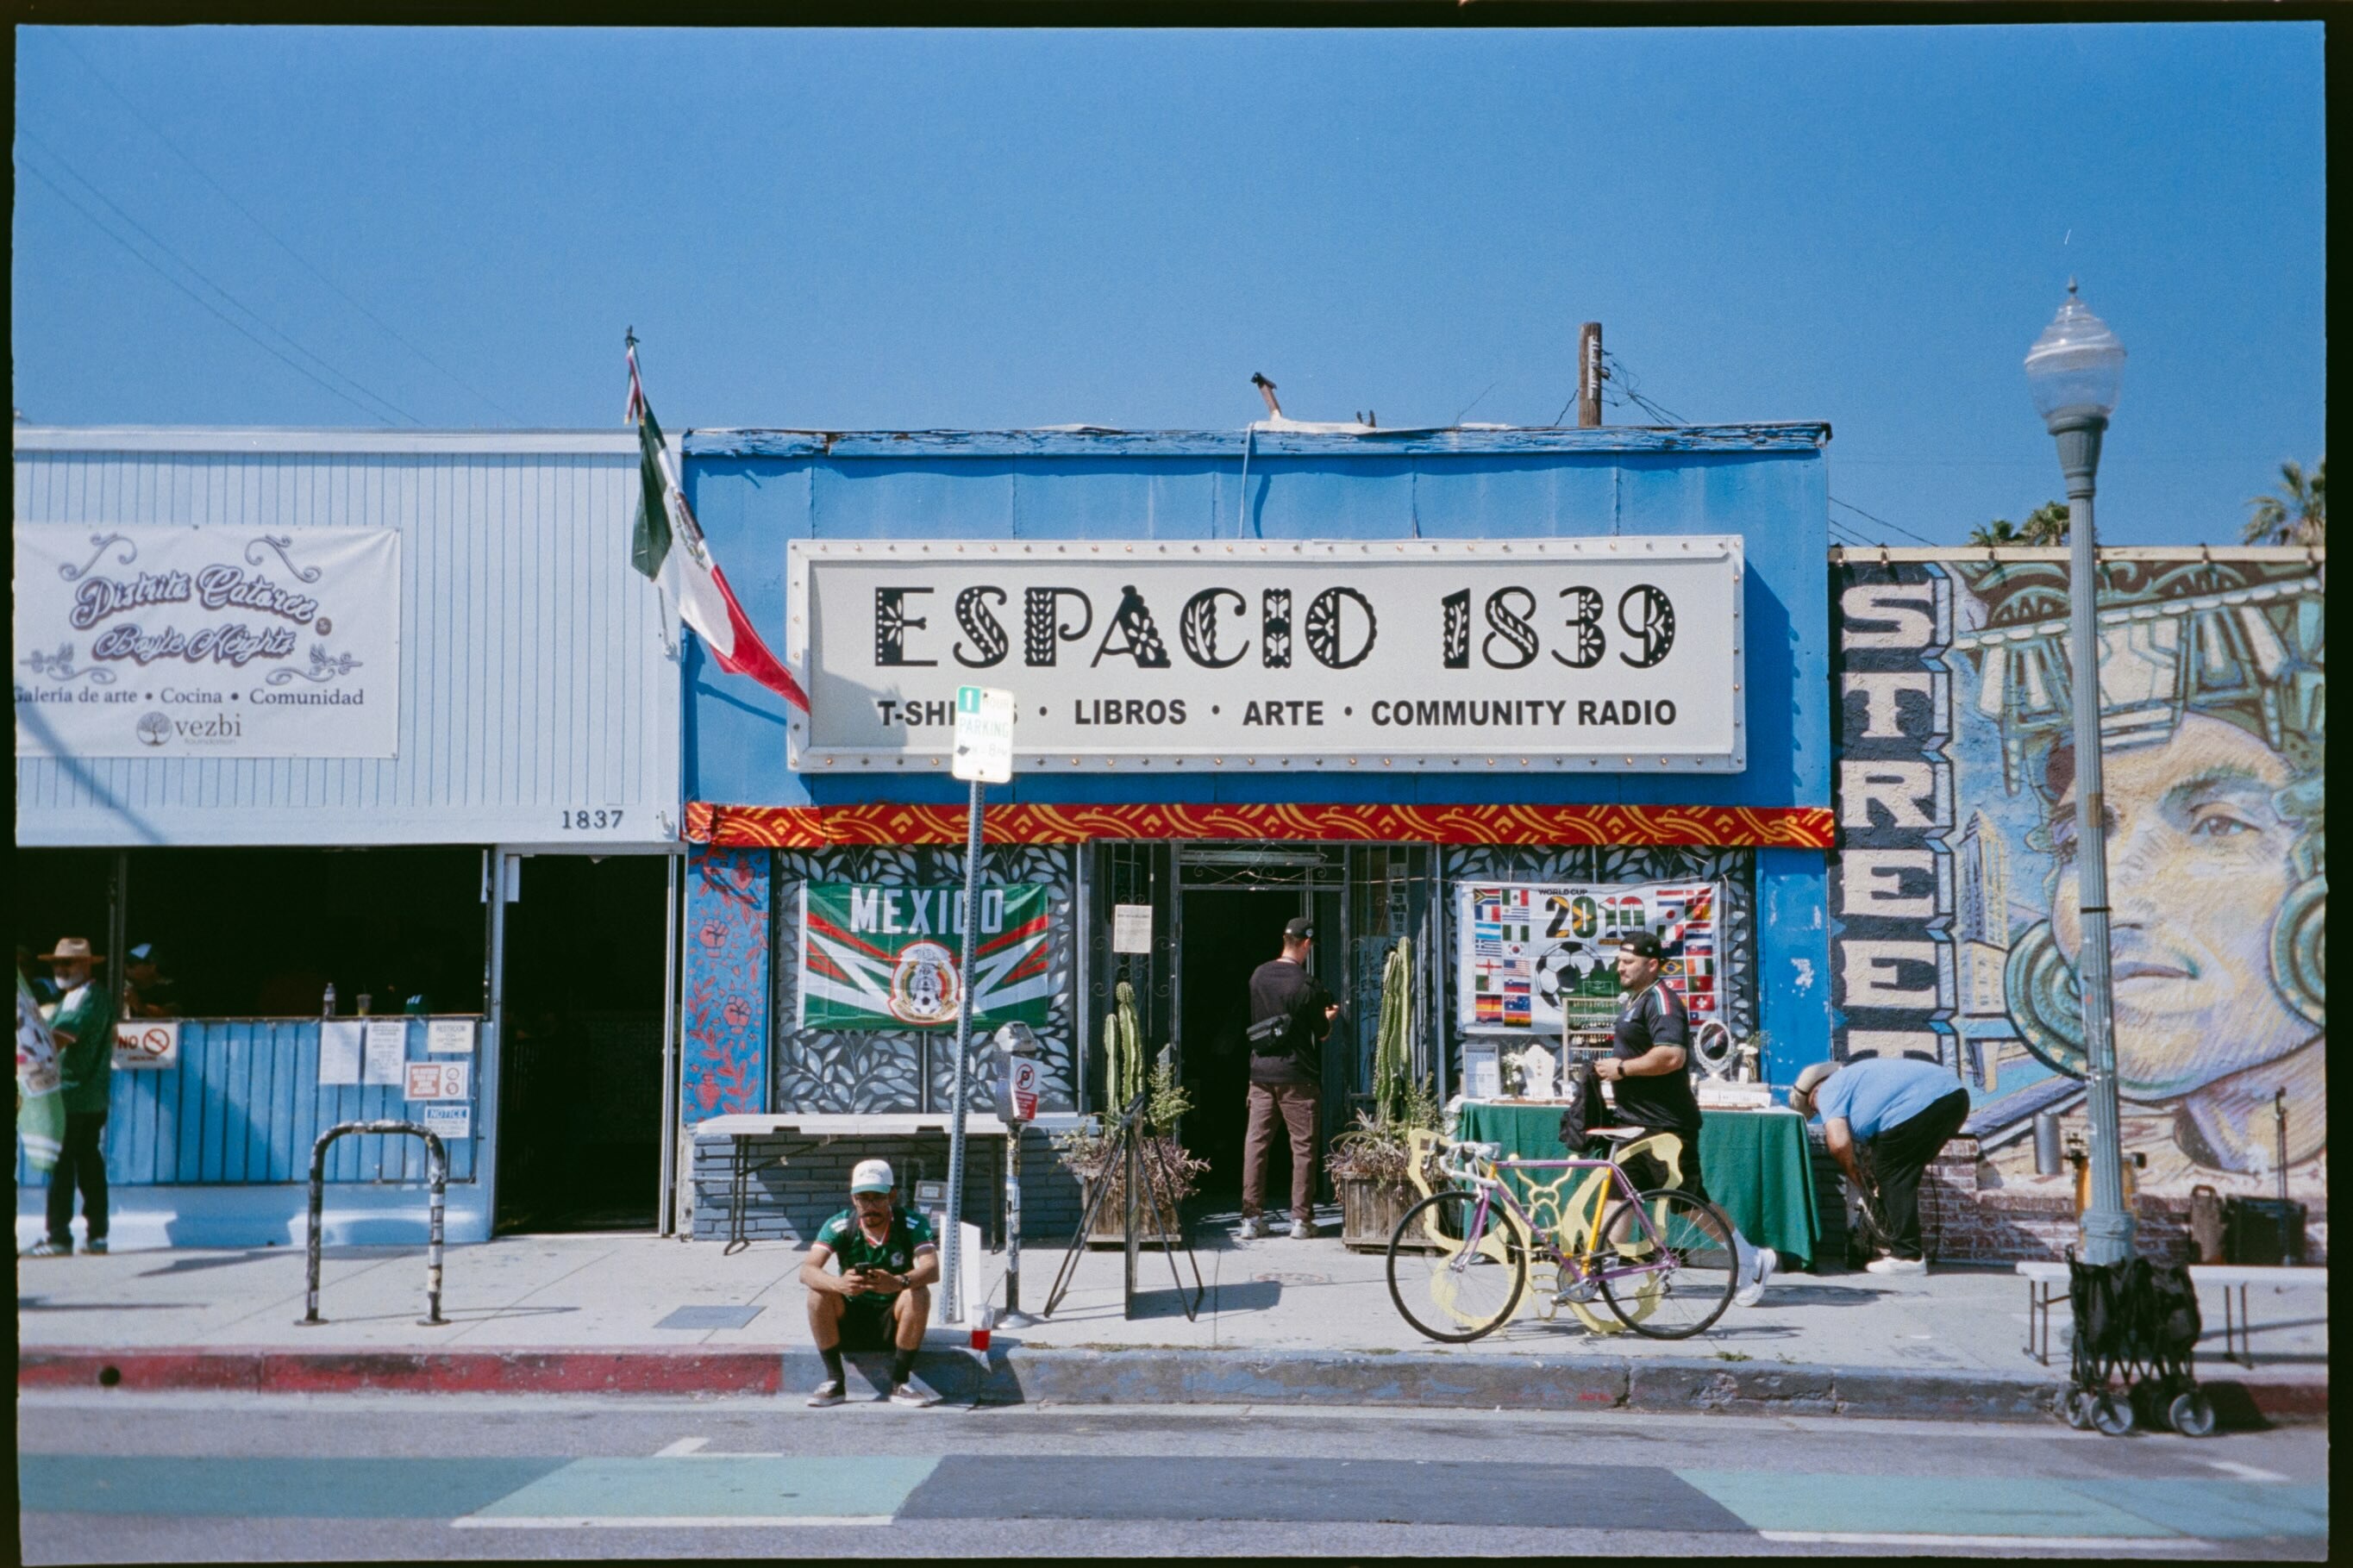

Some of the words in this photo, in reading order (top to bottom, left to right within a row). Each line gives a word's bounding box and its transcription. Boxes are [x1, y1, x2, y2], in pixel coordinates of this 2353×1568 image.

[70, 571, 191, 630] Distrito
[196, 564, 319, 625] Catorce
[874, 584, 1378, 670] ESPACIO
[1442, 584, 1676, 670] 1839
[91, 622, 185, 665] Boyle
[185, 624, 296, 667] Heights
[78, 685, 99, 703] de
[103, 690, 138, 703] arte
[160, 687, 223, 703] Cocina
[249, 688, 364, 705] Comunidad
[175, 714, 241, 736] vezbi
[877, 700, 1017, 727] T-SHI
[1074, 699, 1187, 726] LIBROS
[1242, 700, 1324, 726] ARTE
[1371, 700, 1567, 726] COMMUNITY
[1578, 699, 1677, 726] RADIO
[960, 717, 1009, 738] PARKING
[562, 809, 623, 829] 1837
[1840, 579, 1937, 1063] STREE
[1545, 896, 1646, 939] 2010
[117, 1035, 139, 1049] NO
[430, 1109, 464, 1119] NOTICE
